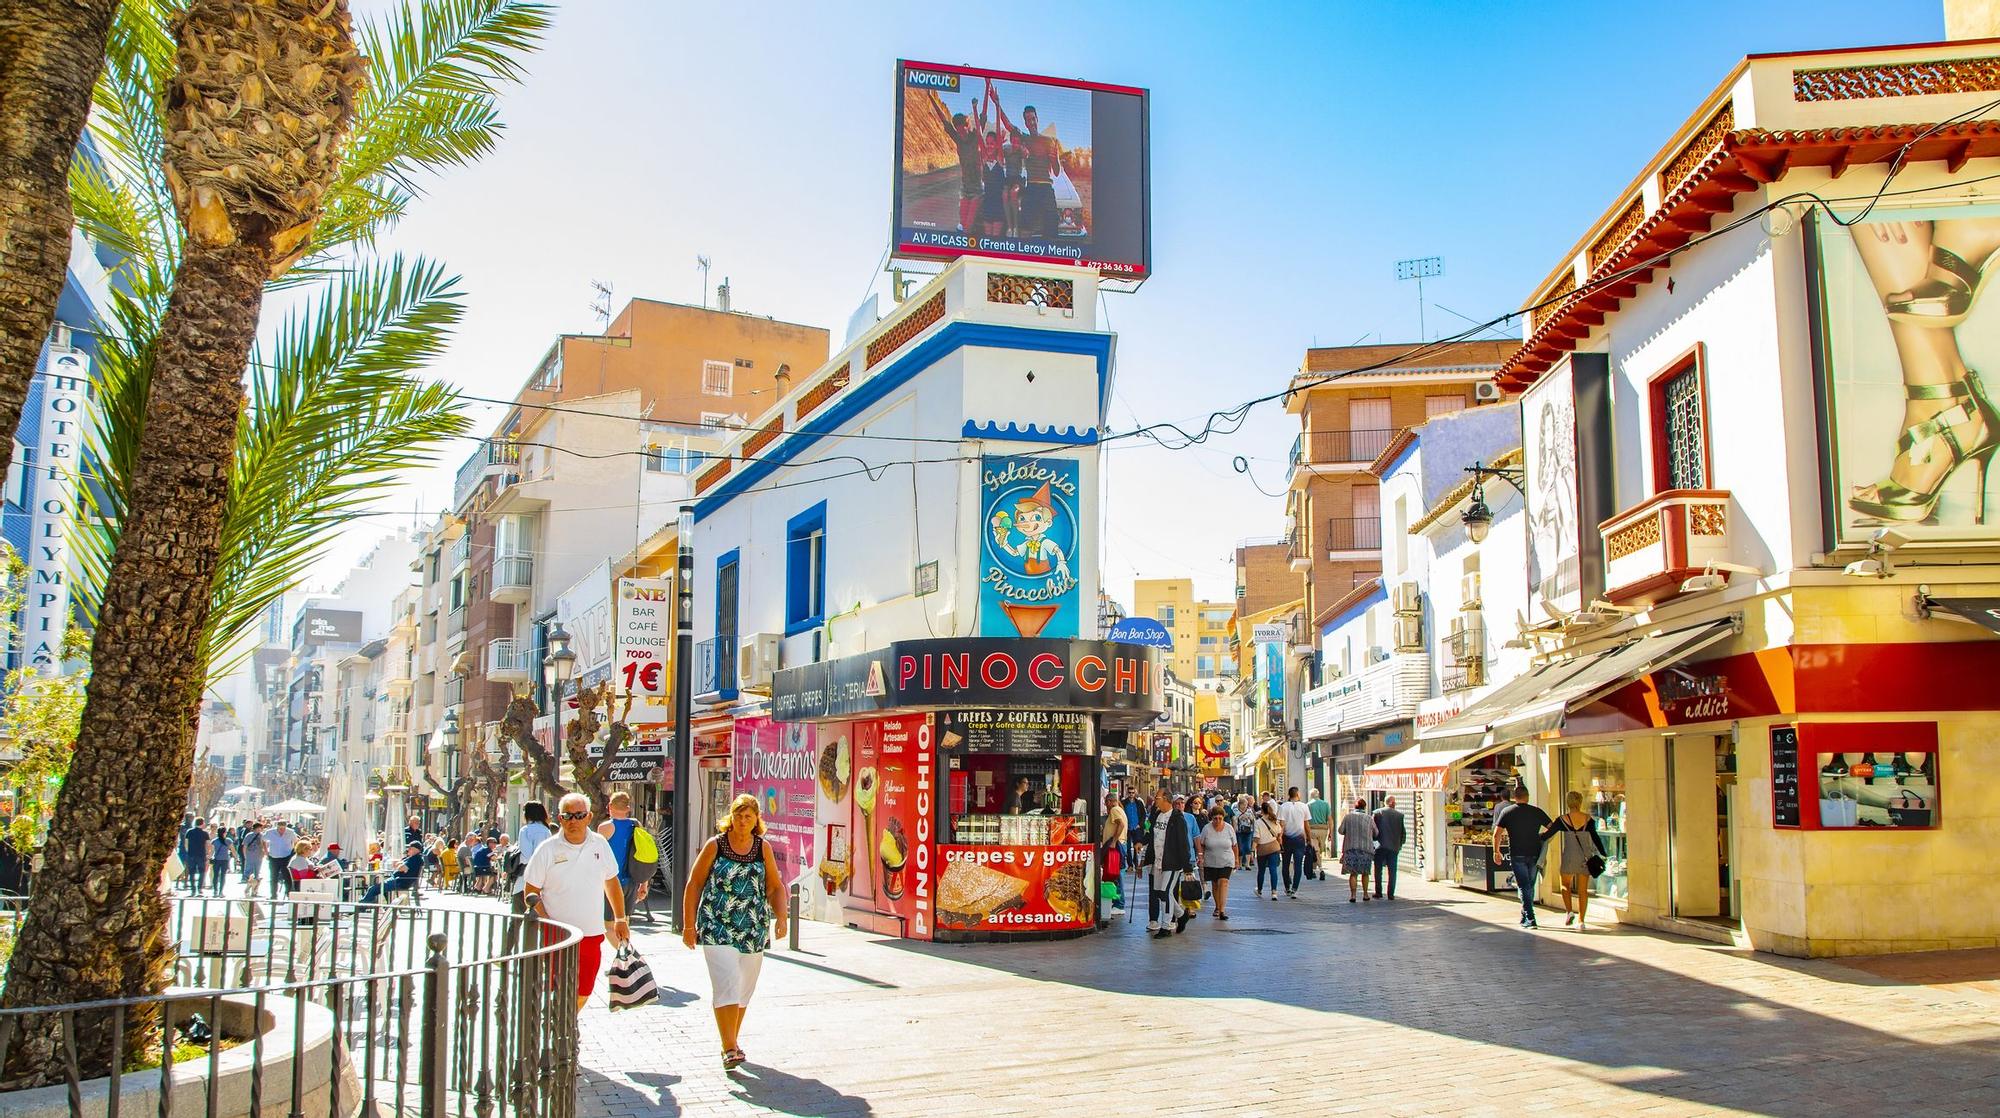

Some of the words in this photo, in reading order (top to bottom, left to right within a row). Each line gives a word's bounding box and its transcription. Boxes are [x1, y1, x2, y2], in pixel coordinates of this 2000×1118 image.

[909, 71, 958, 88] Norauto
[912, 232, 929, 243] AV.
[931, 233, 977, 248] PICASSO
[979, 238, 1016, 252] (Frente
[1018, 242, 1046, 256] Leroy
[1048, 244, 1082, 259] Merlin)
[47, 376, 77, 483] HOTEL
[983, 461, 1076, 497] Gelateria
[32, 498, 67, 655] OLYMPIA
[623, 580, 635, 588] The
[632, 608, 655, 617] BAR
[628, 621, 659, 631] CAFÉ
[1111, 627, 1128, 640] Bon
[1128, 627, 1144, 640] Bon
[1144, 628, 1165, 644] Shop
[1254, 629, 1281, 637] IVORRA
[620, 636, 666, 647] LOUNGE
[626, 650, 653, 659] TODO
[622, 661, 663, 692] 1€
[899, 652, 1164, 695] PINOCCHIO
[1685, 696, 1729, 718] addict
[957, 711, 993, 723] CREPES
[1008, 711, 1049, 723] GOFRES
[883, 720, 902, 731] Helado
[968, 722, 988, 730] Crepe
[883, 732, 909, 742] Artesanal
[883, 744, 903, 753] Italiano
[640, 761, 657, 769] con
[609, 769, 645, 780] Churros
[1398, 773, 1416, 788] TOTAL
[1416, 772, 1434, 788] TODO
[915, 723, 930, 935] PINOCCHIO
[945, 850, 1015, 867] crepes
[1023, 851, 1035, 867] y
[1042, 847, 1093, 867] gofres
[988, 912, 1072, 924] artesanos
